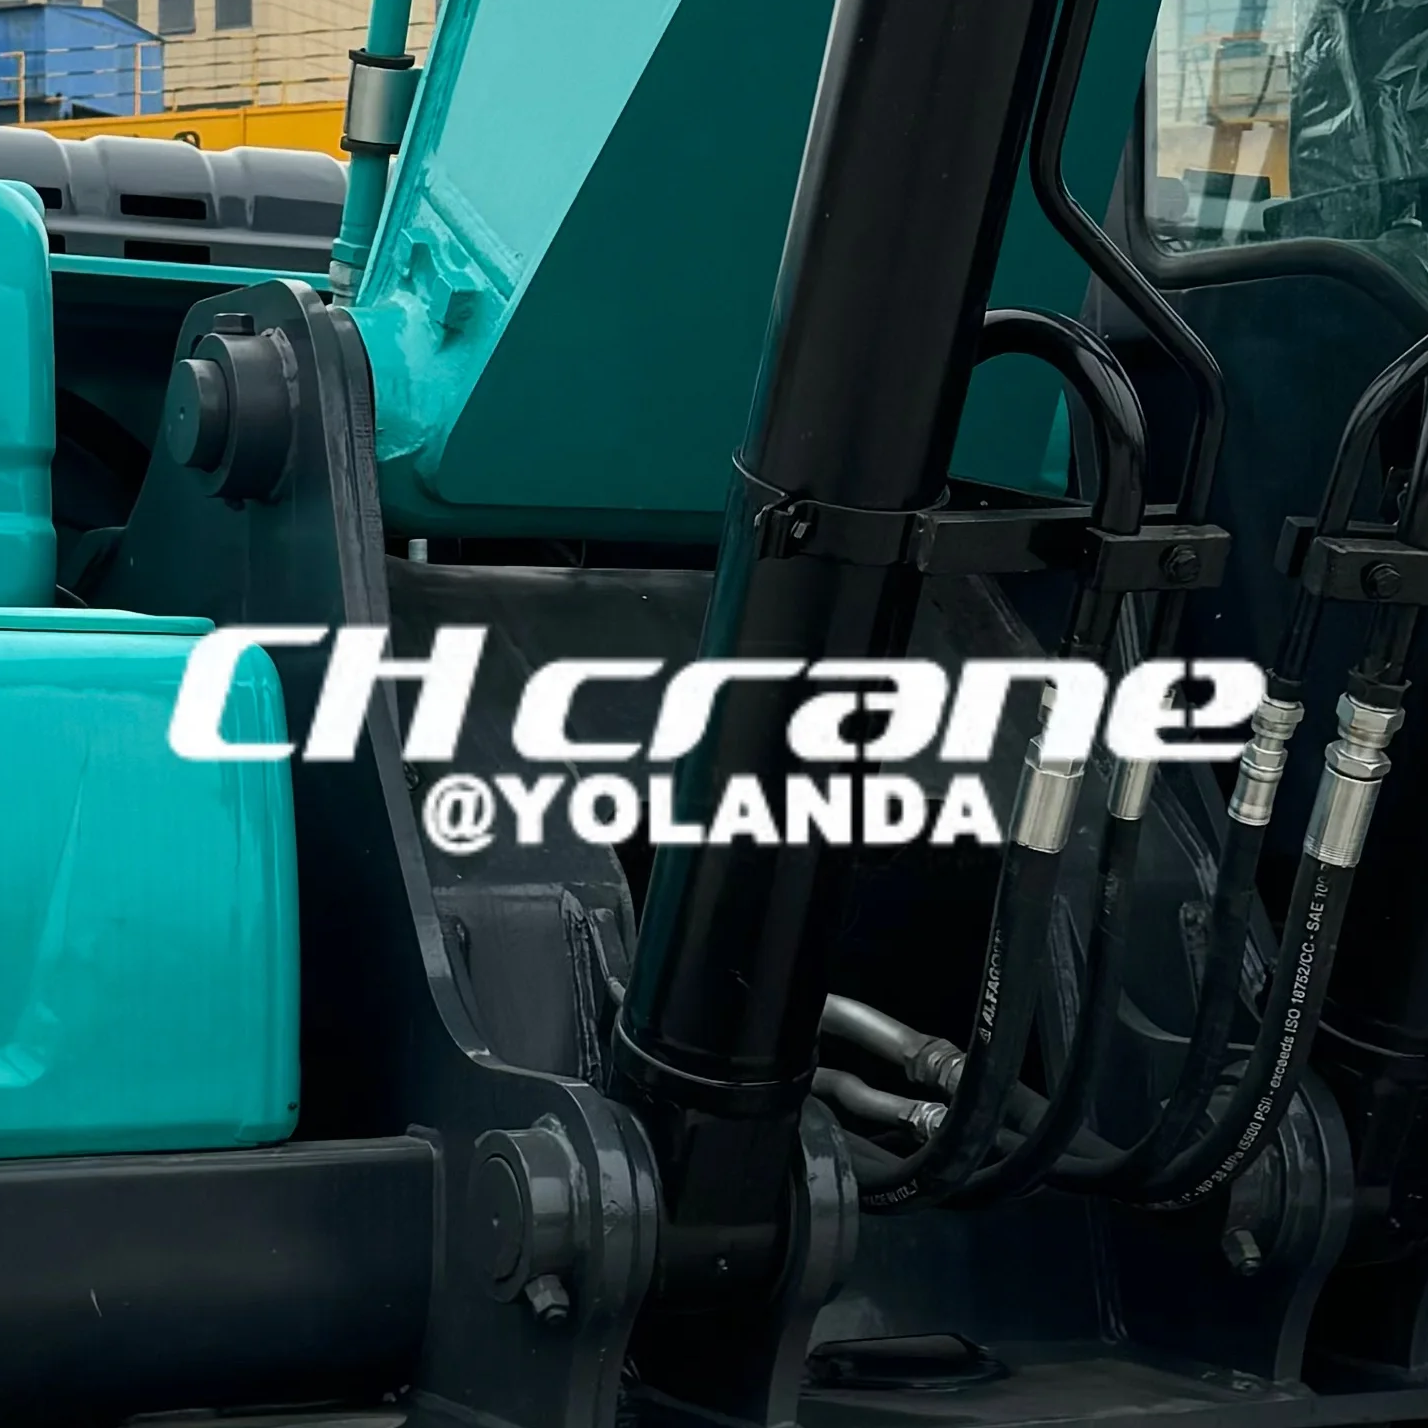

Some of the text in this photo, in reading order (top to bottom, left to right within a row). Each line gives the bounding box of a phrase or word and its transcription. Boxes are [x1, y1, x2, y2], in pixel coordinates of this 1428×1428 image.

[1305, 901, 1325, 932] SAE
[1290, 942, 1316, 1004] 18752/CC
[1284, 1008, 1301, 1033] ISO
[1269, 1035, 1295, 1089] exceeds
[1237, 1121, 1263, 1151] (5500
